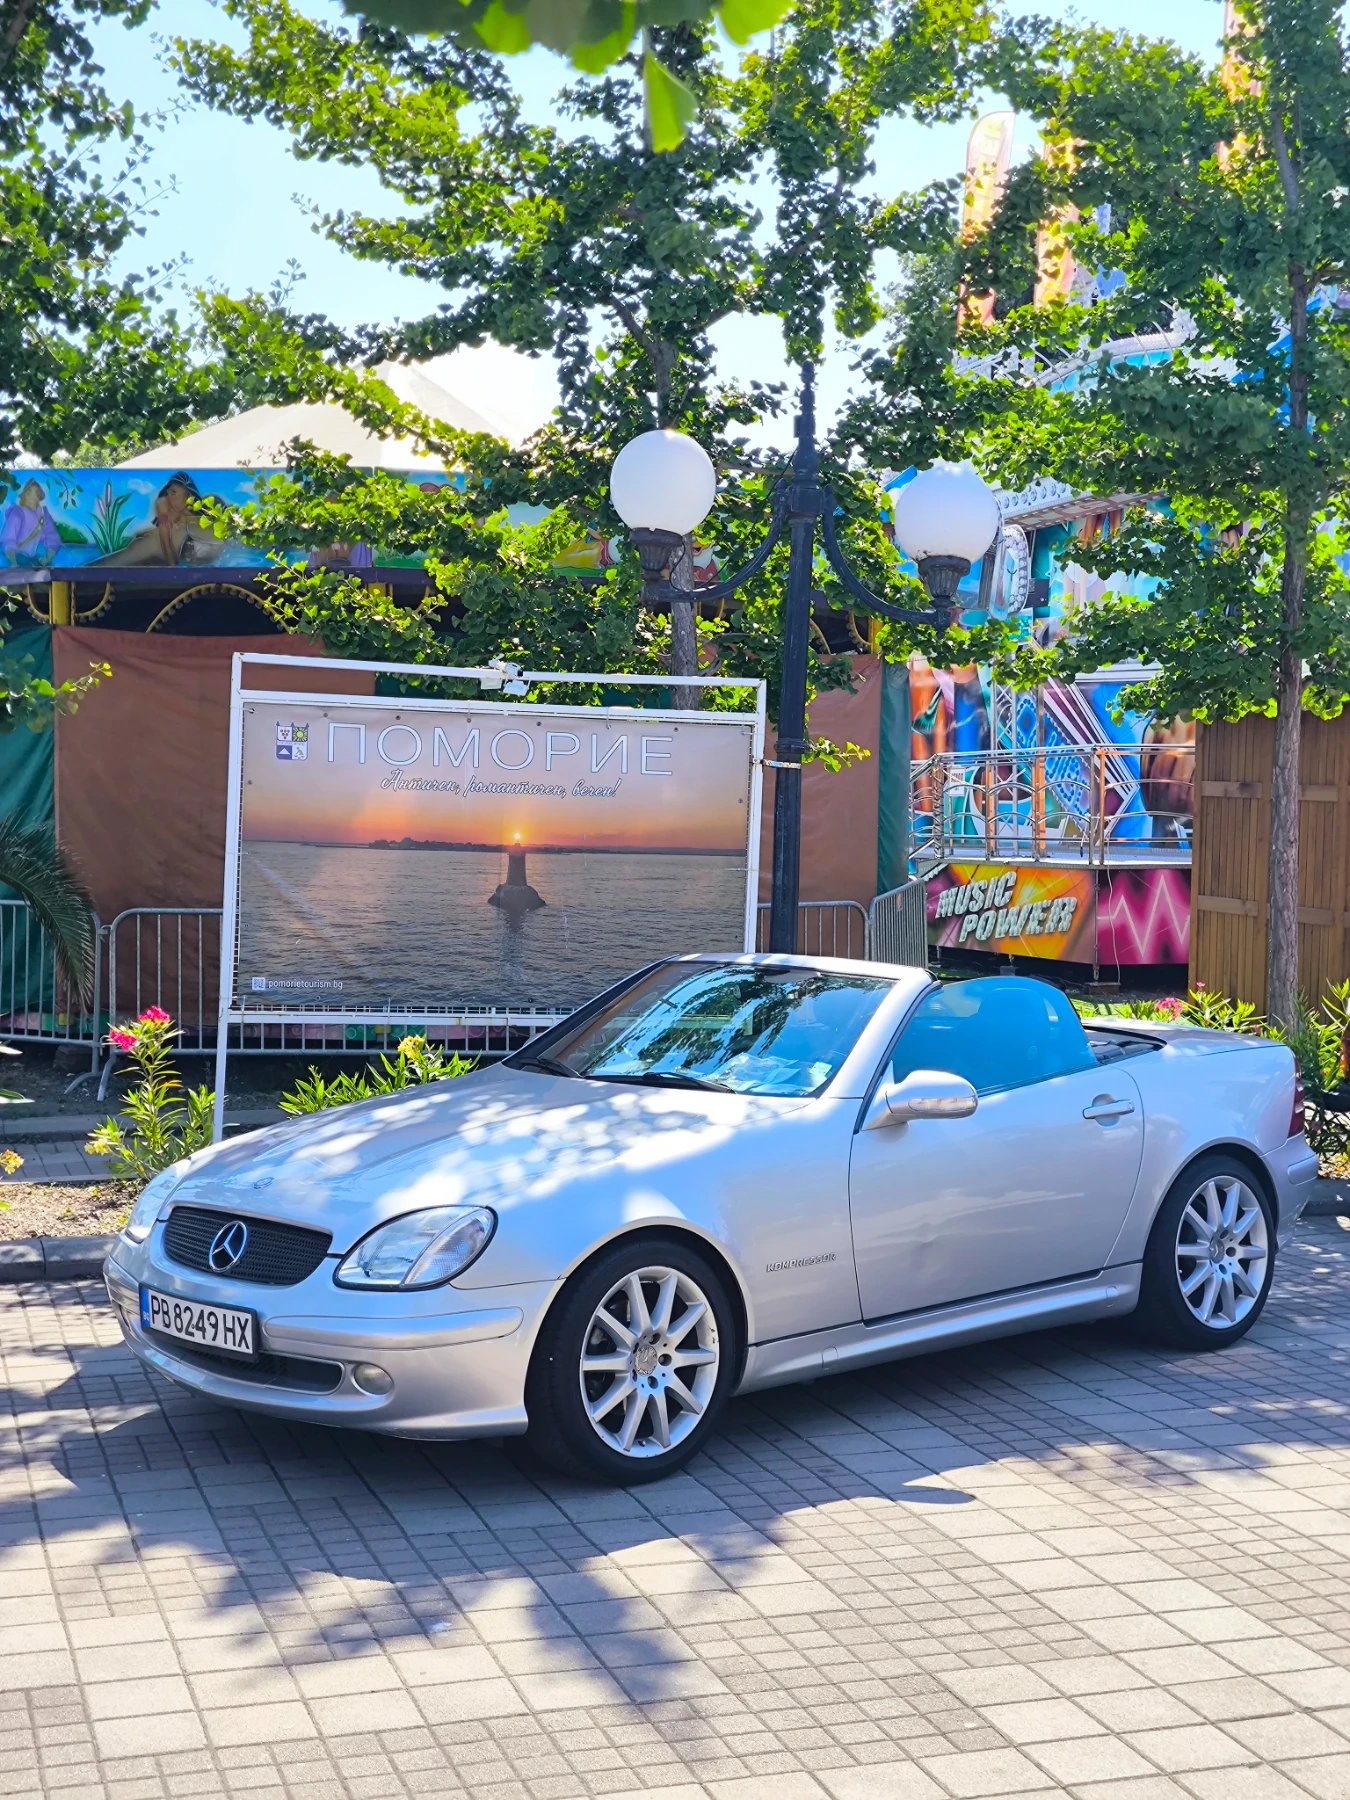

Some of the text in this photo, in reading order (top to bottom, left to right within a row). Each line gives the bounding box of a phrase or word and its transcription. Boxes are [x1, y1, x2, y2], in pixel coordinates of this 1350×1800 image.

[327, 722, 673, 776] ПОМОРИЕ
[571, 778, 622, 797] вечен!
[935, 871, 1017, 919] MUSIC
[958, 897, 1077, 943] POWER
[268, 979, 343, 991] pomorietourism.bg
[766, 1252, 837, 1273] KOMPRESSOR
